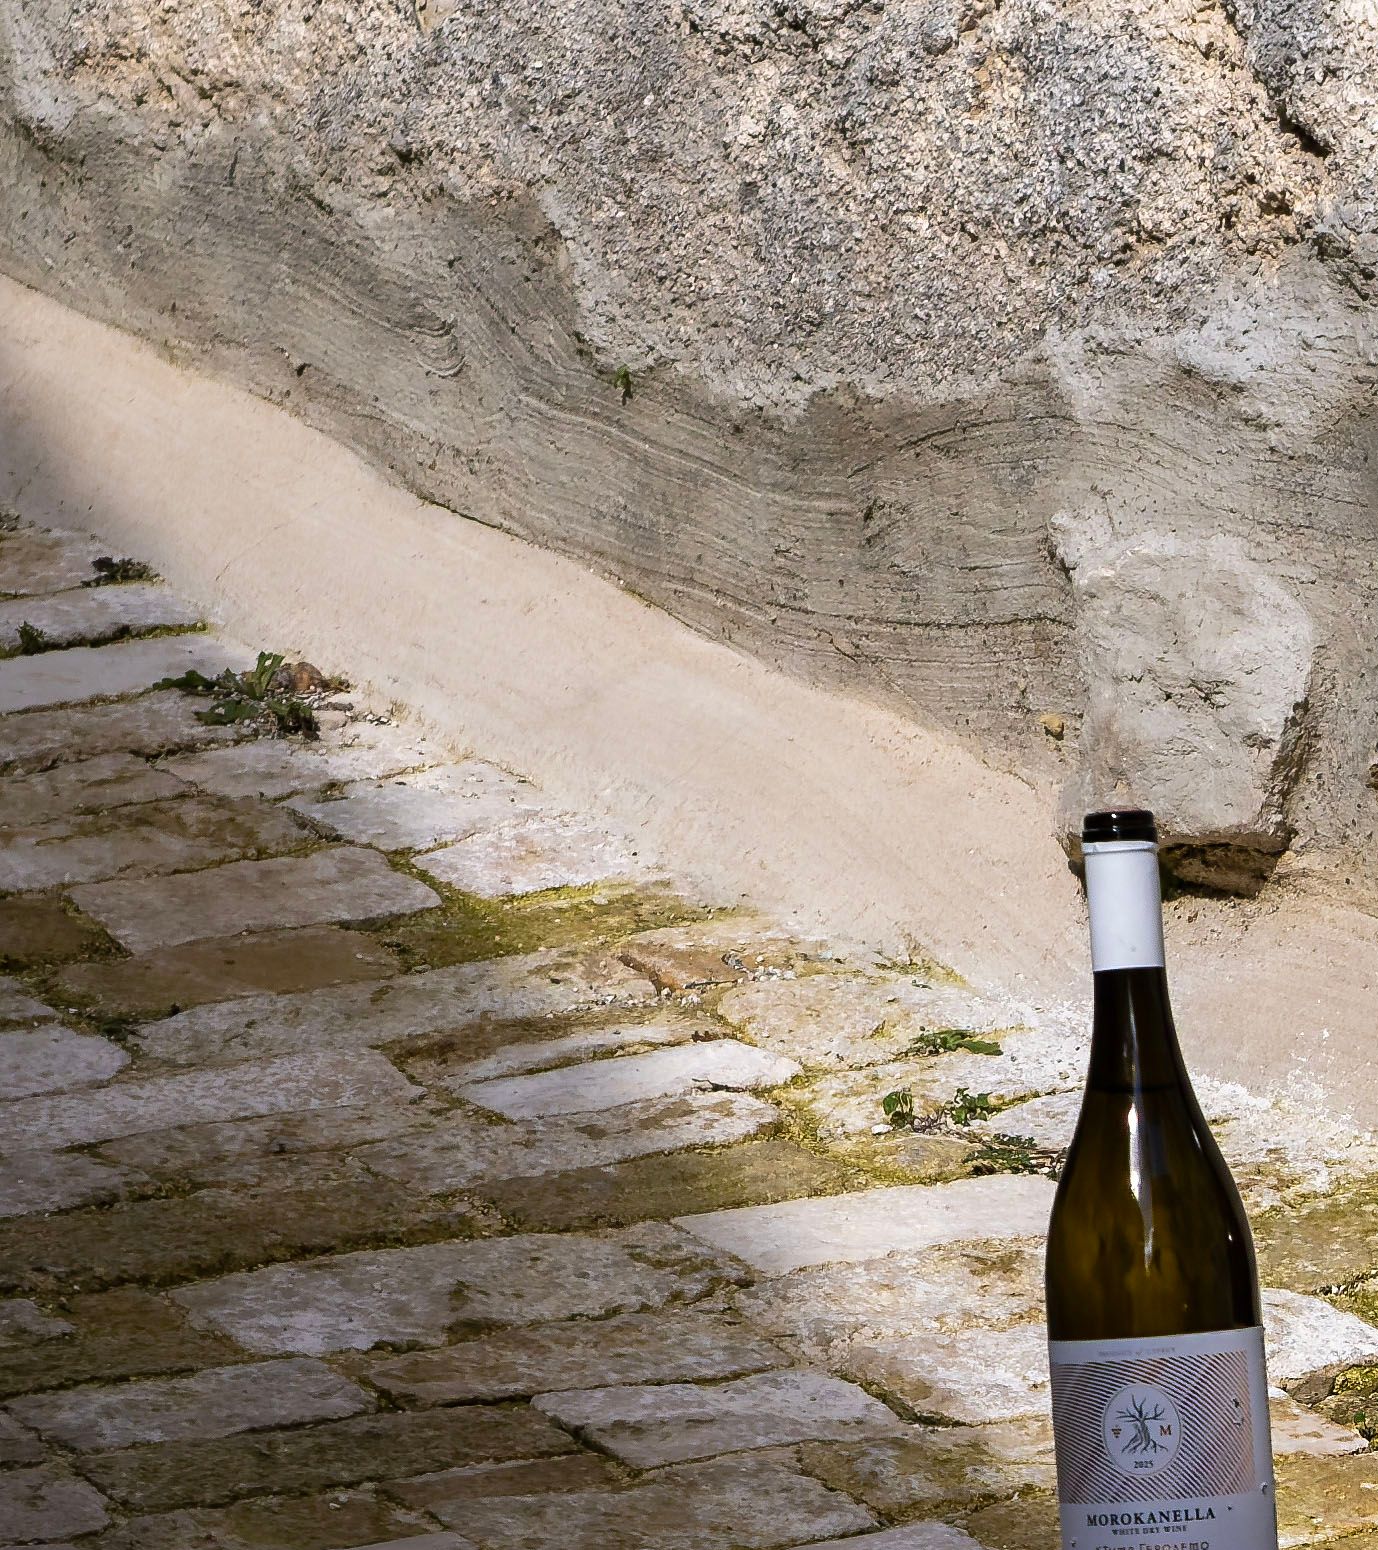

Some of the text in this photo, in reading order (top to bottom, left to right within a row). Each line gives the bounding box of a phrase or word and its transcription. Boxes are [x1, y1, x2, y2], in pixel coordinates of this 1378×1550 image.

[1087, 1507, 1216, 1527] MOROKANELLA
[1112, 1525, 1188, 1536] WHITE DRY WINE
